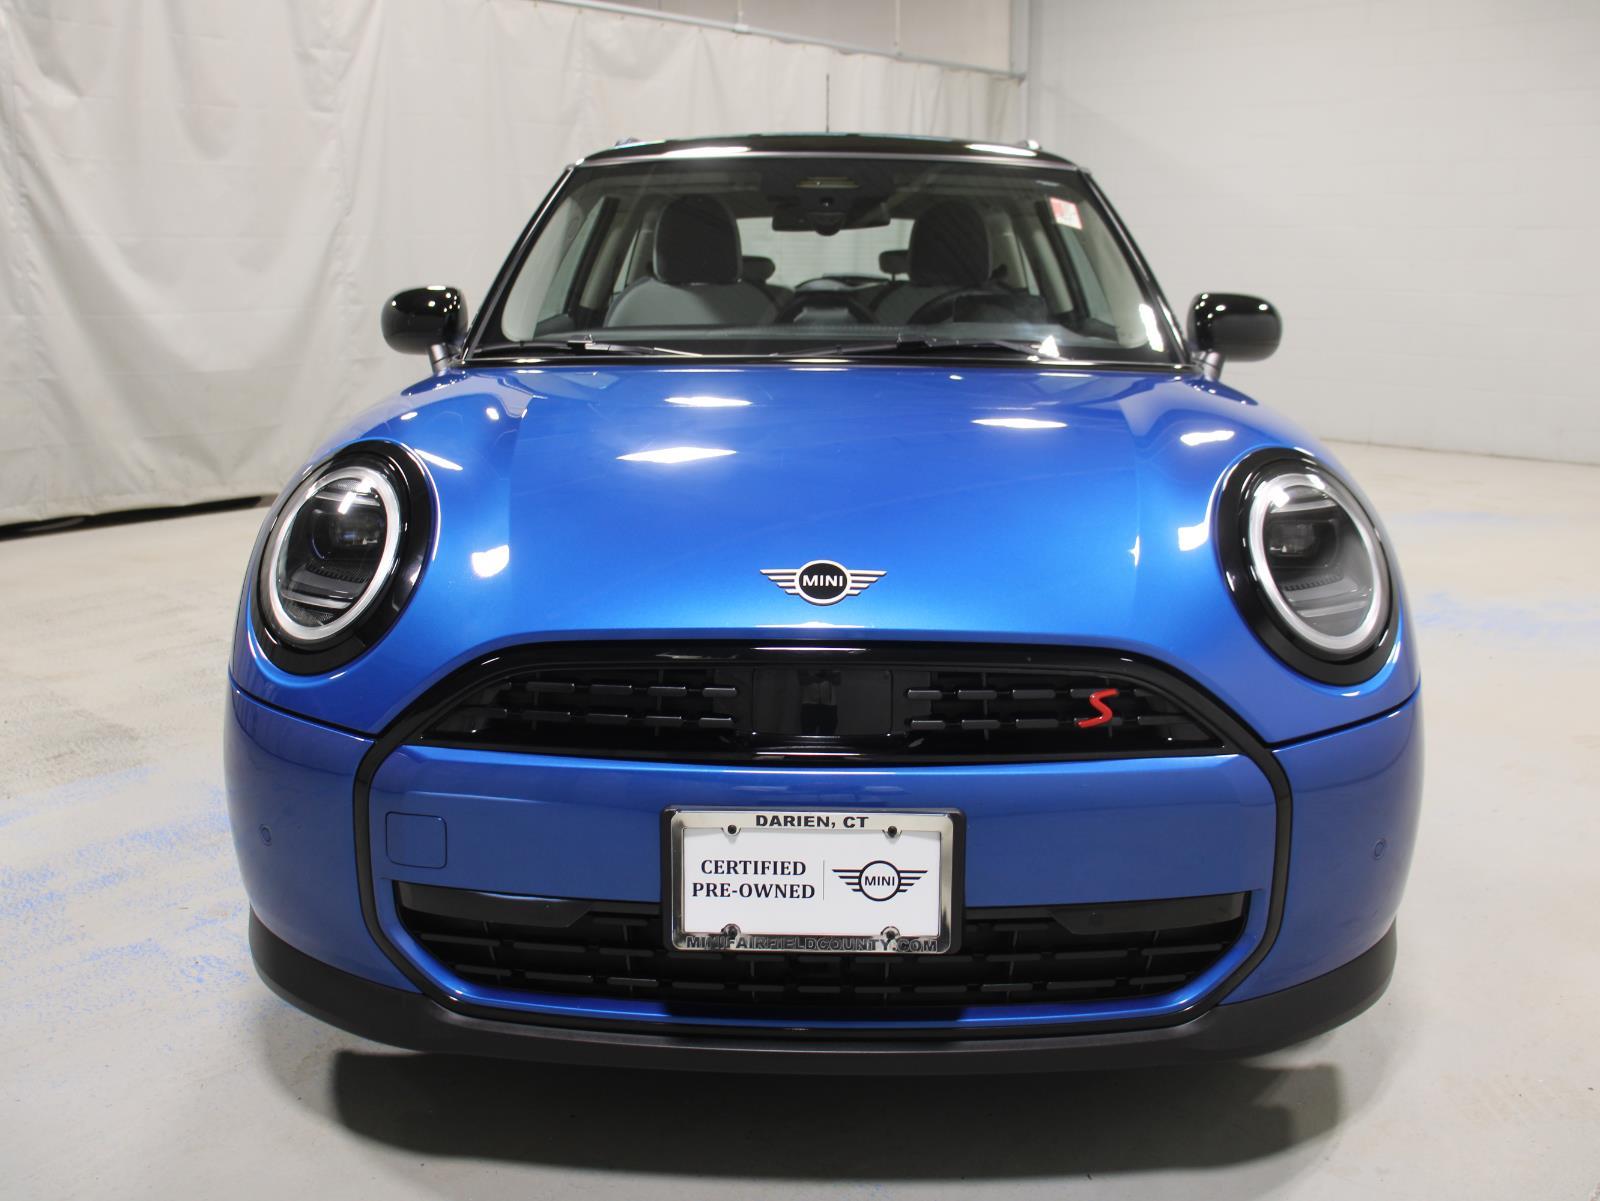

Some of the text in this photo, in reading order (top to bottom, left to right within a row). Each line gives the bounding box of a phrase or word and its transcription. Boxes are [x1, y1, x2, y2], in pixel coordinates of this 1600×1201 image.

[802, 574, 844, 587] MINI
[1077, 688, 1119, 728] S
[756, 814, 869, 829] DARIEN, CT
[701, 859, 807, 876] CERTIFIED
[864, 875, 896, 887] MINI
[692, 882, 815, 899] PRE-OWNED
